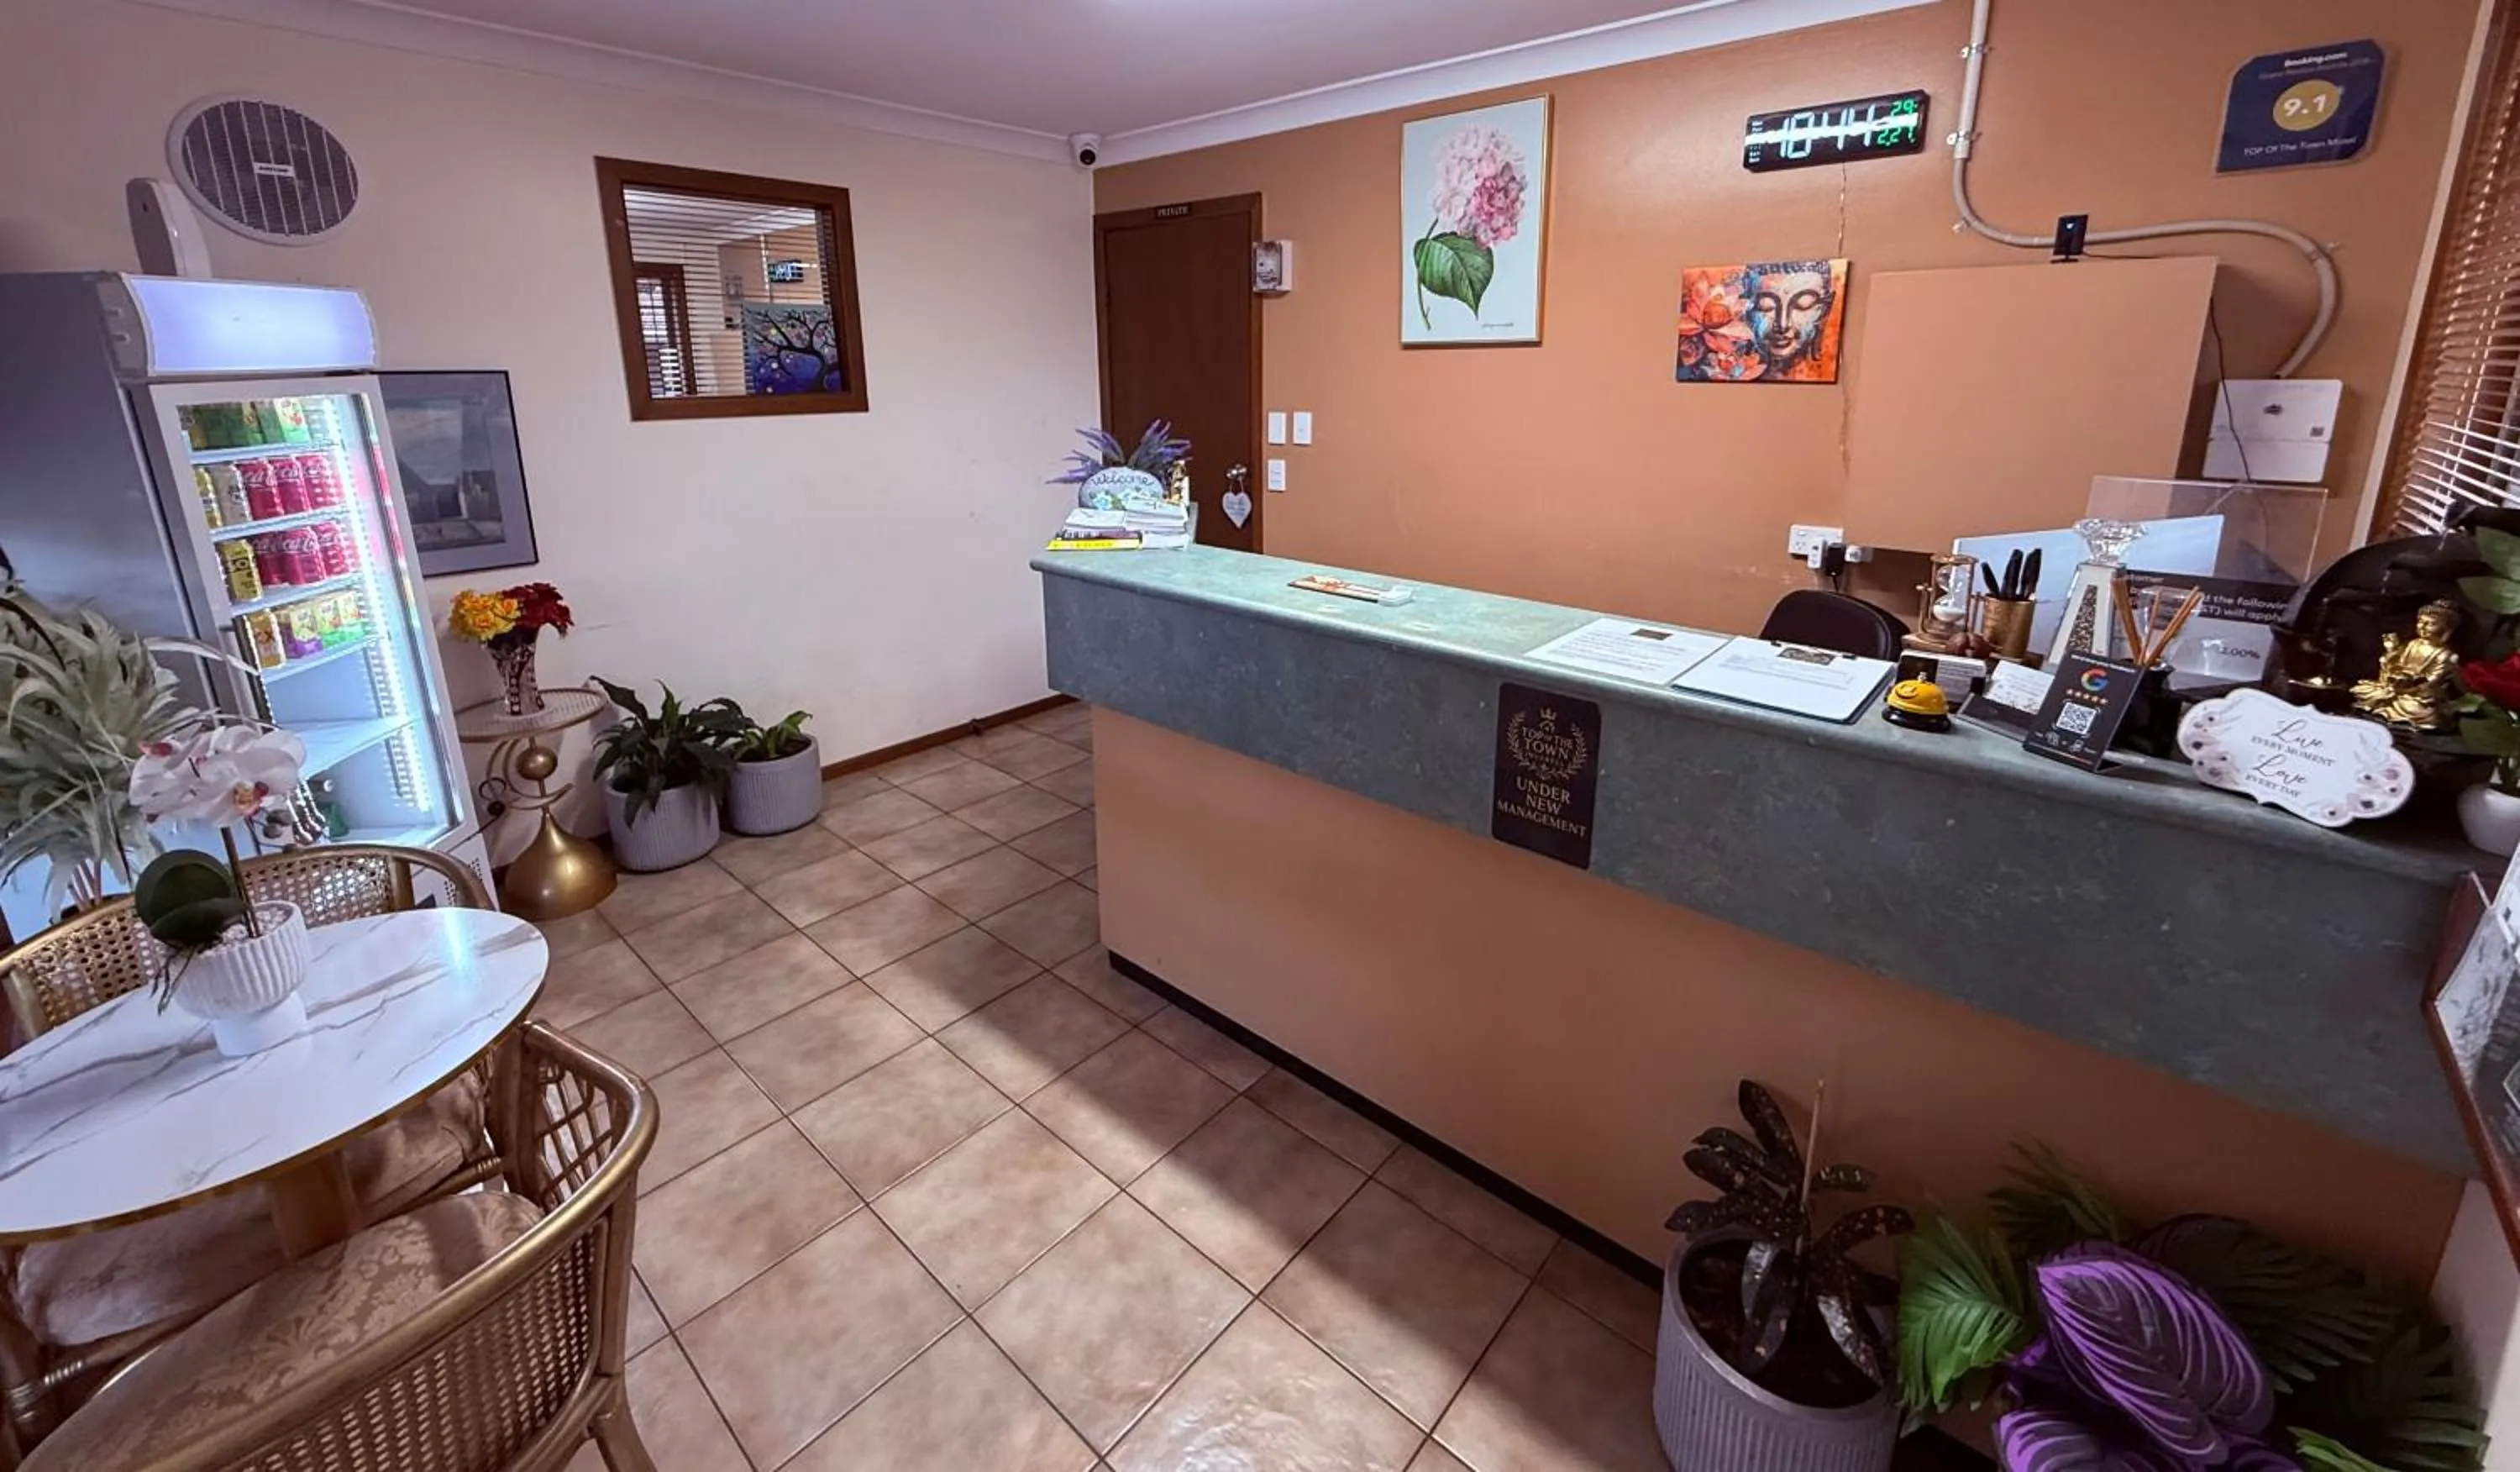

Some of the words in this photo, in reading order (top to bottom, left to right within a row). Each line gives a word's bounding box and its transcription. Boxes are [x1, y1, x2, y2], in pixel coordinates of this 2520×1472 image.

[2283, 51, 2349, 67] Booking.com
[2283, 93, 2328, 118] 9.1
[2244, 146, 2264, 155] TOP
[2280, 142, 2297, 153] The
[2213, 595, 2234, 605] the
[2236, 597, 2288, 610] followin
[2223, 608, 2246, 618] will
[1521, 725, 1545, 740] TOP
[1555, 735, 1573, 750] THE
[1524, 737, 1569, 760] TOWN
[2284, 744, 2337, 768] MOMENT
[1515, 775, 1571, 805] UNDER
[1525, 794, 1563, 816] NEW
[1496, 799, 1588, 839] MANAGEMENT
